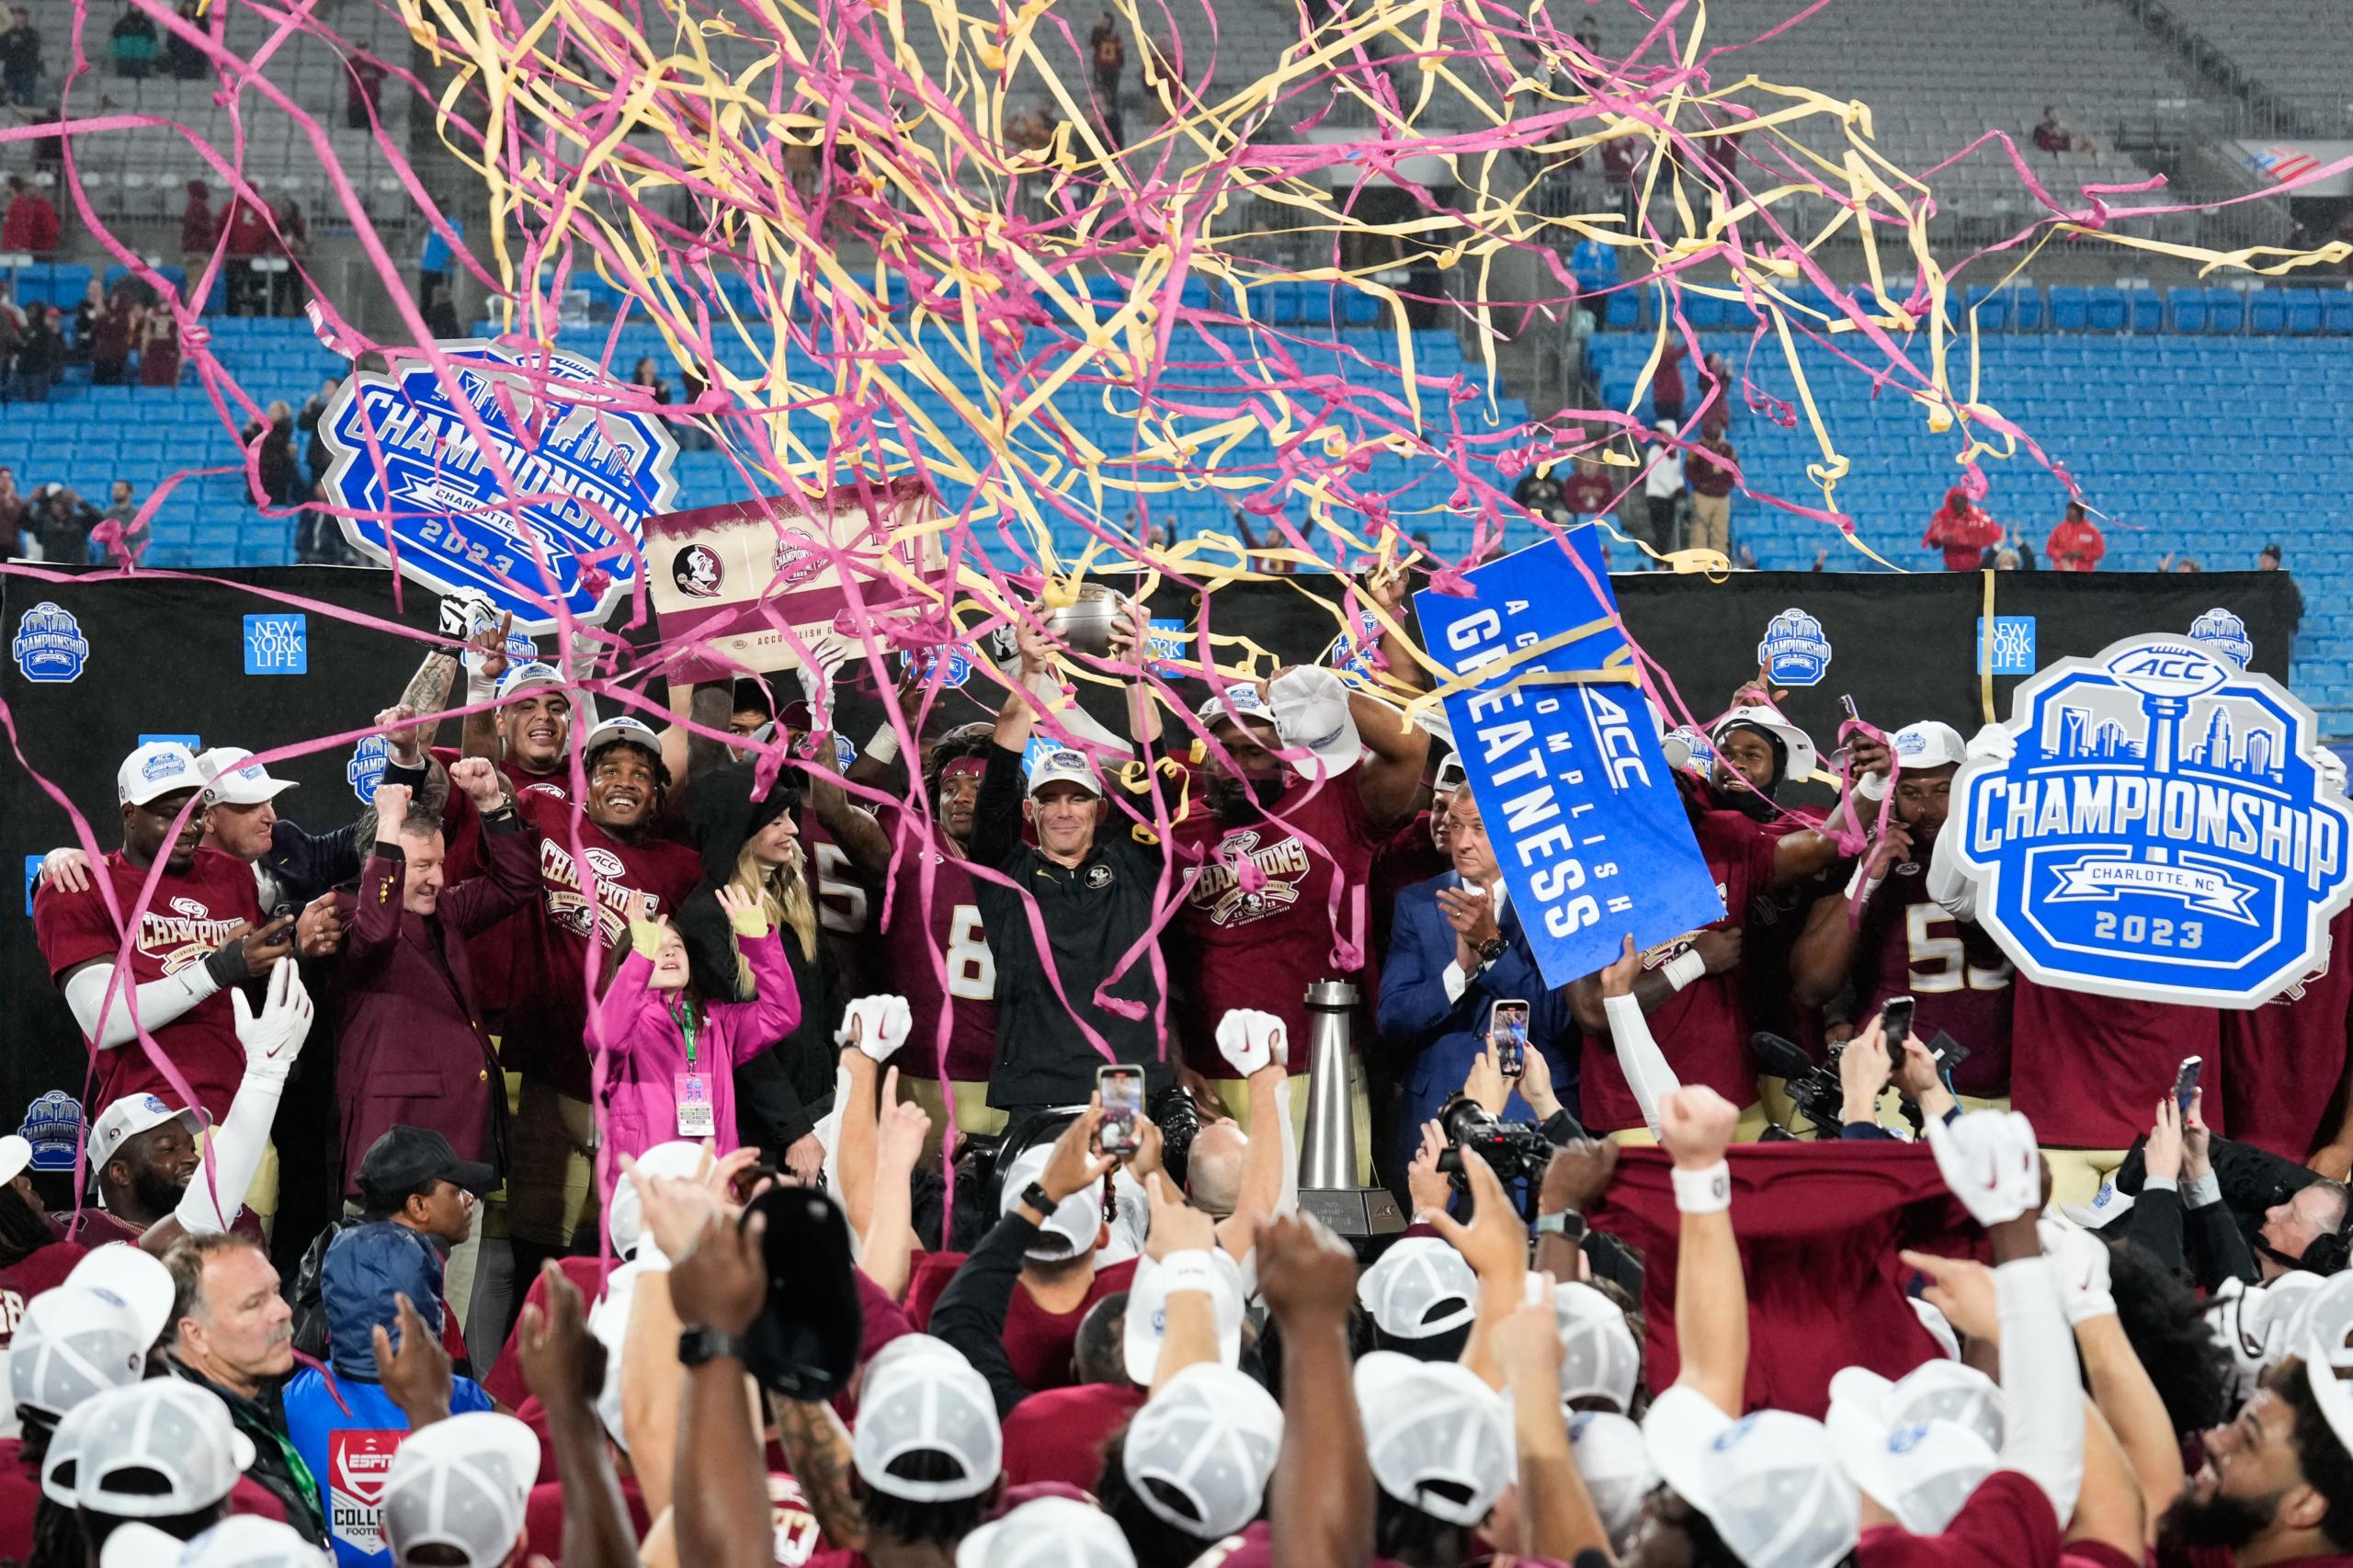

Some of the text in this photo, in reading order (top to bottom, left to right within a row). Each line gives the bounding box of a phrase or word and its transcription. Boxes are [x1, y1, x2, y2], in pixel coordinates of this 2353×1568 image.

[419, 518, 515, 577] 2023
[256, 621, 298, 637] NEW
[757, 628, 822, 645] ACCOLISH
[17, 634, 85, 659] CHAMPIONSHIP
[247, 636, 302, 653] YORK
[1762, 639, 1829, 662] CHAMPIONSHIP
[257, 651, 297, 667] LIFE
[2128, 658, 2211, 680] ACC
[1585, 685, 1652, 790] ACC
[142, 759, 185, 777] CHAMPIONS
[1224, 834, 1252, 850] ACC
[1974, 775, 2340, 892] CHAMPIONSHIP
[589, 855, 619, 871] ACC
[541, 845, 658, 917] CHAPIOS
[2195, 878, 2214, 892] NC
[2094, 910, 2203, 949] 2023
[348, 1453, 393, 1469] ESPN
